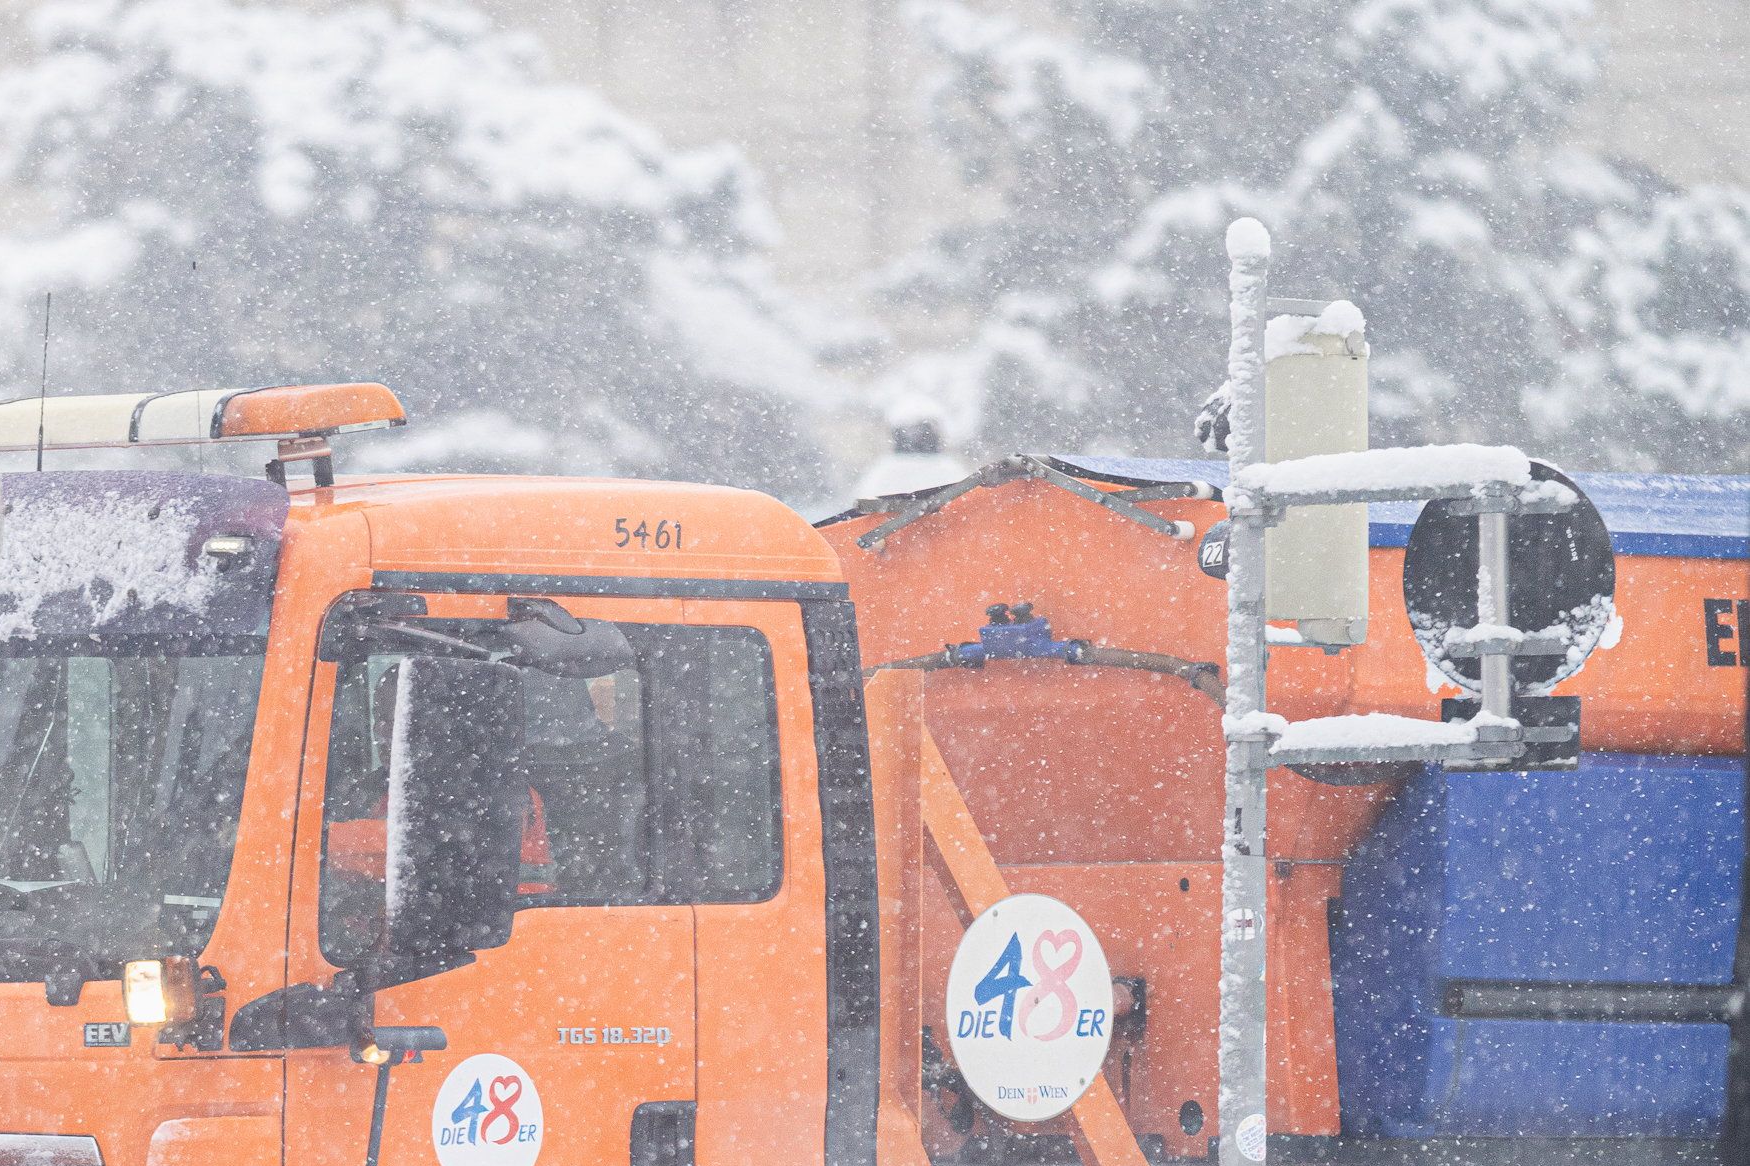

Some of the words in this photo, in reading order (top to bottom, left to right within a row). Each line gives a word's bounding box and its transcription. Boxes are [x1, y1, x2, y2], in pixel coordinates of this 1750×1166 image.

[614, 517, 682, 550] 5461
[1204, 542, 1223, 567] 22
[85, 1024, 129, 1043] EEV
[957, 1010, 996, 1039] DIE
[557, 1027, 596, 1045] TGS
[602, 1027, 670, 1045] 18.320
[998, 1086, 1025, 1100] DEIN
[1038, 1085, 1068, 1098] WIEN
[440, 1126, 466, 1146] DIE
